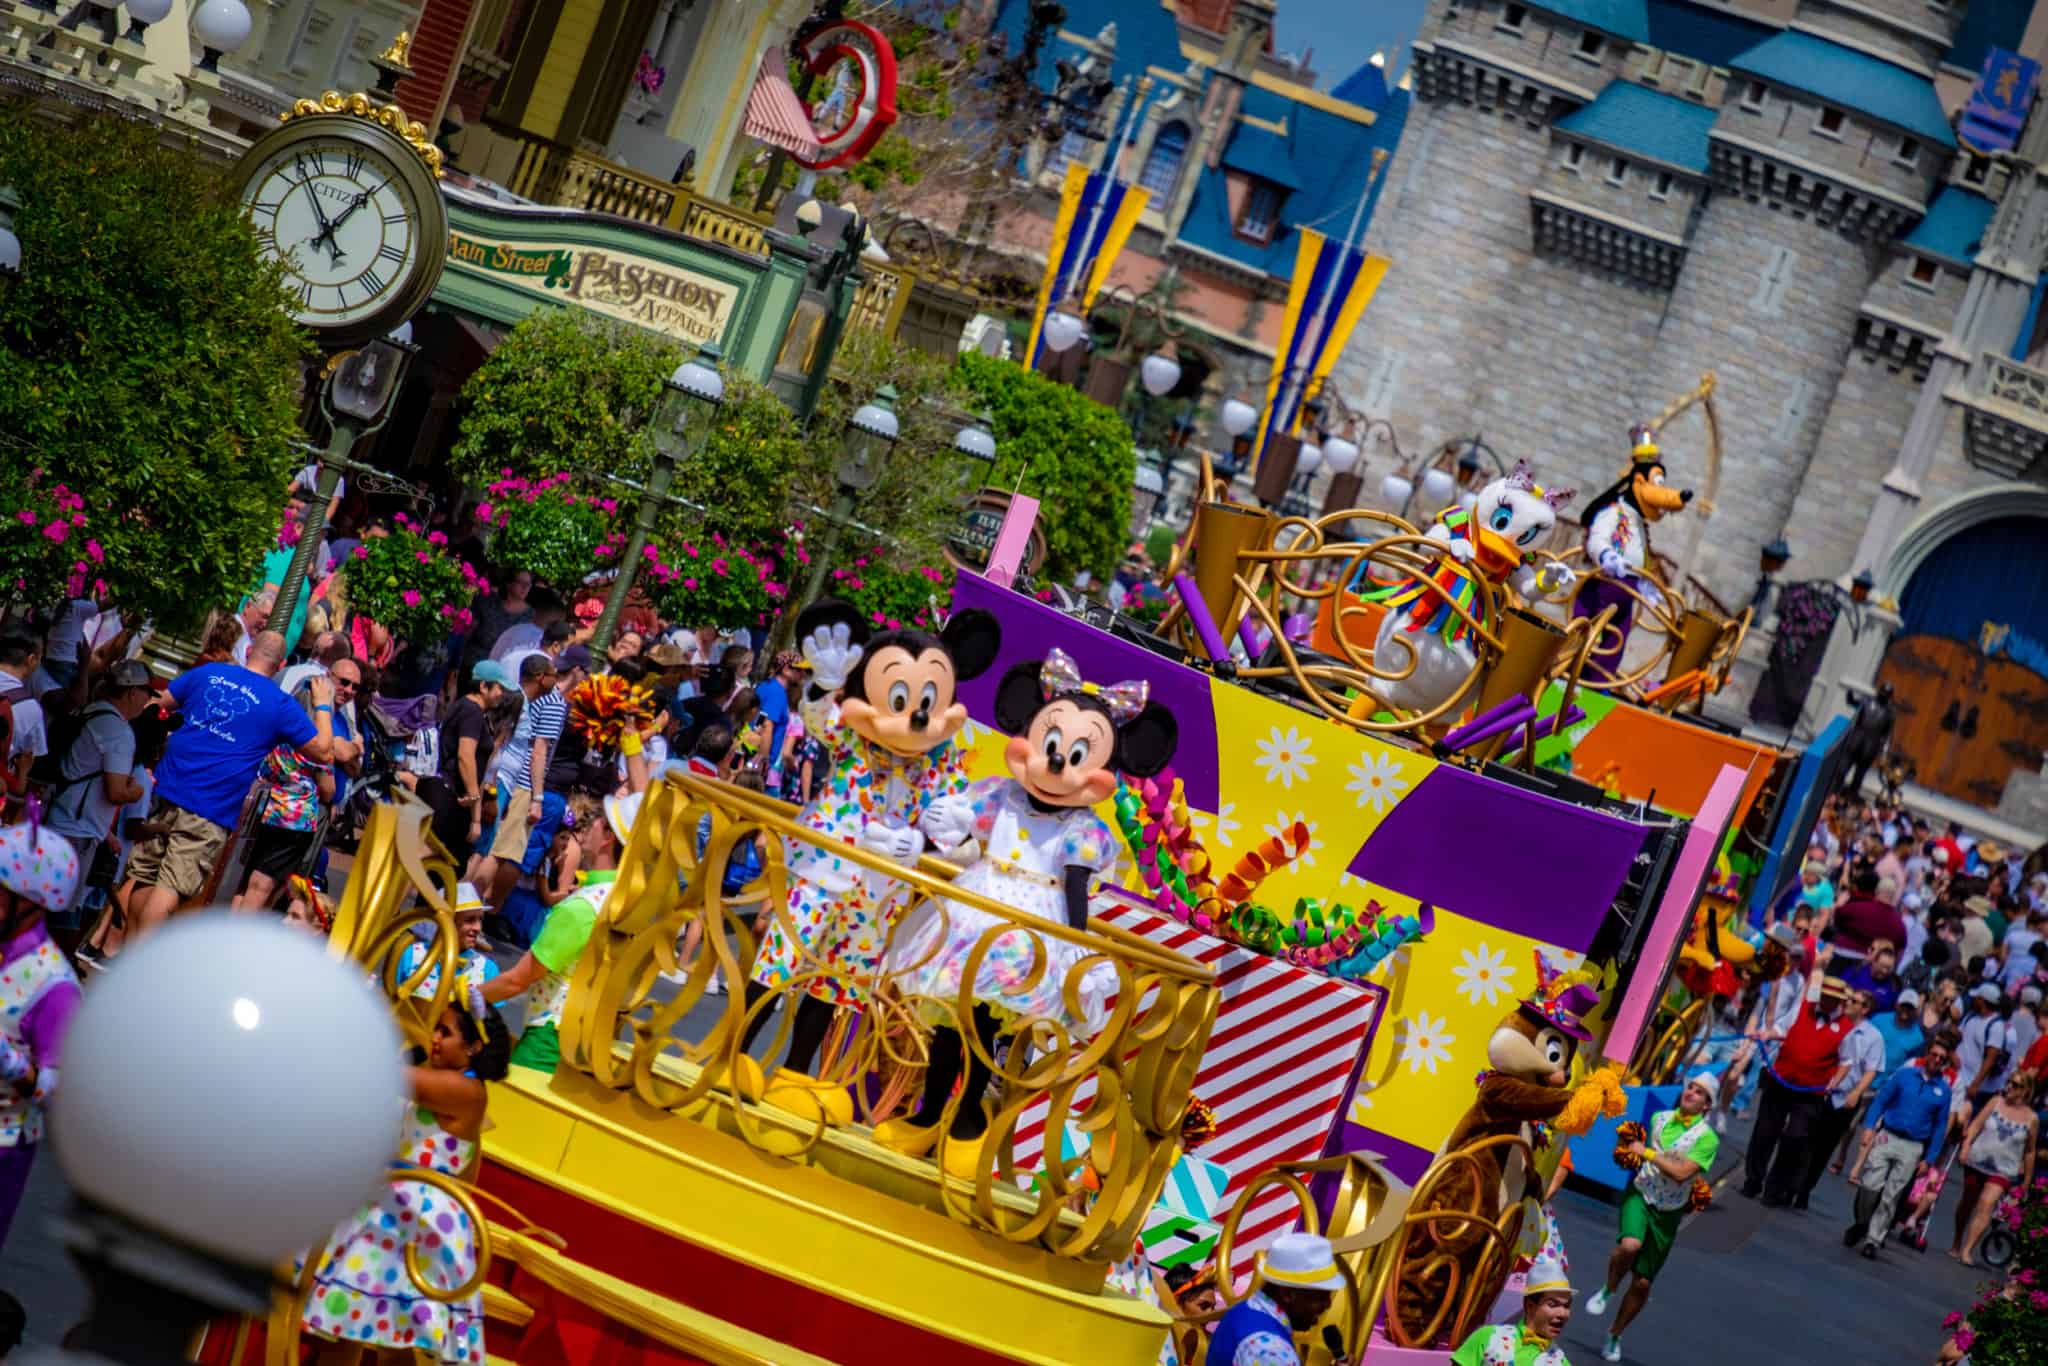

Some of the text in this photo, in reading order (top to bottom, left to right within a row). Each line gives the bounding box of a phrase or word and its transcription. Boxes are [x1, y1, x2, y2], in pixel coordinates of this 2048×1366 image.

[313, 181, 367, 210] CITIZ
[491, 242, 556, 273] Street
[565, 252, 725, 320] FASHION
